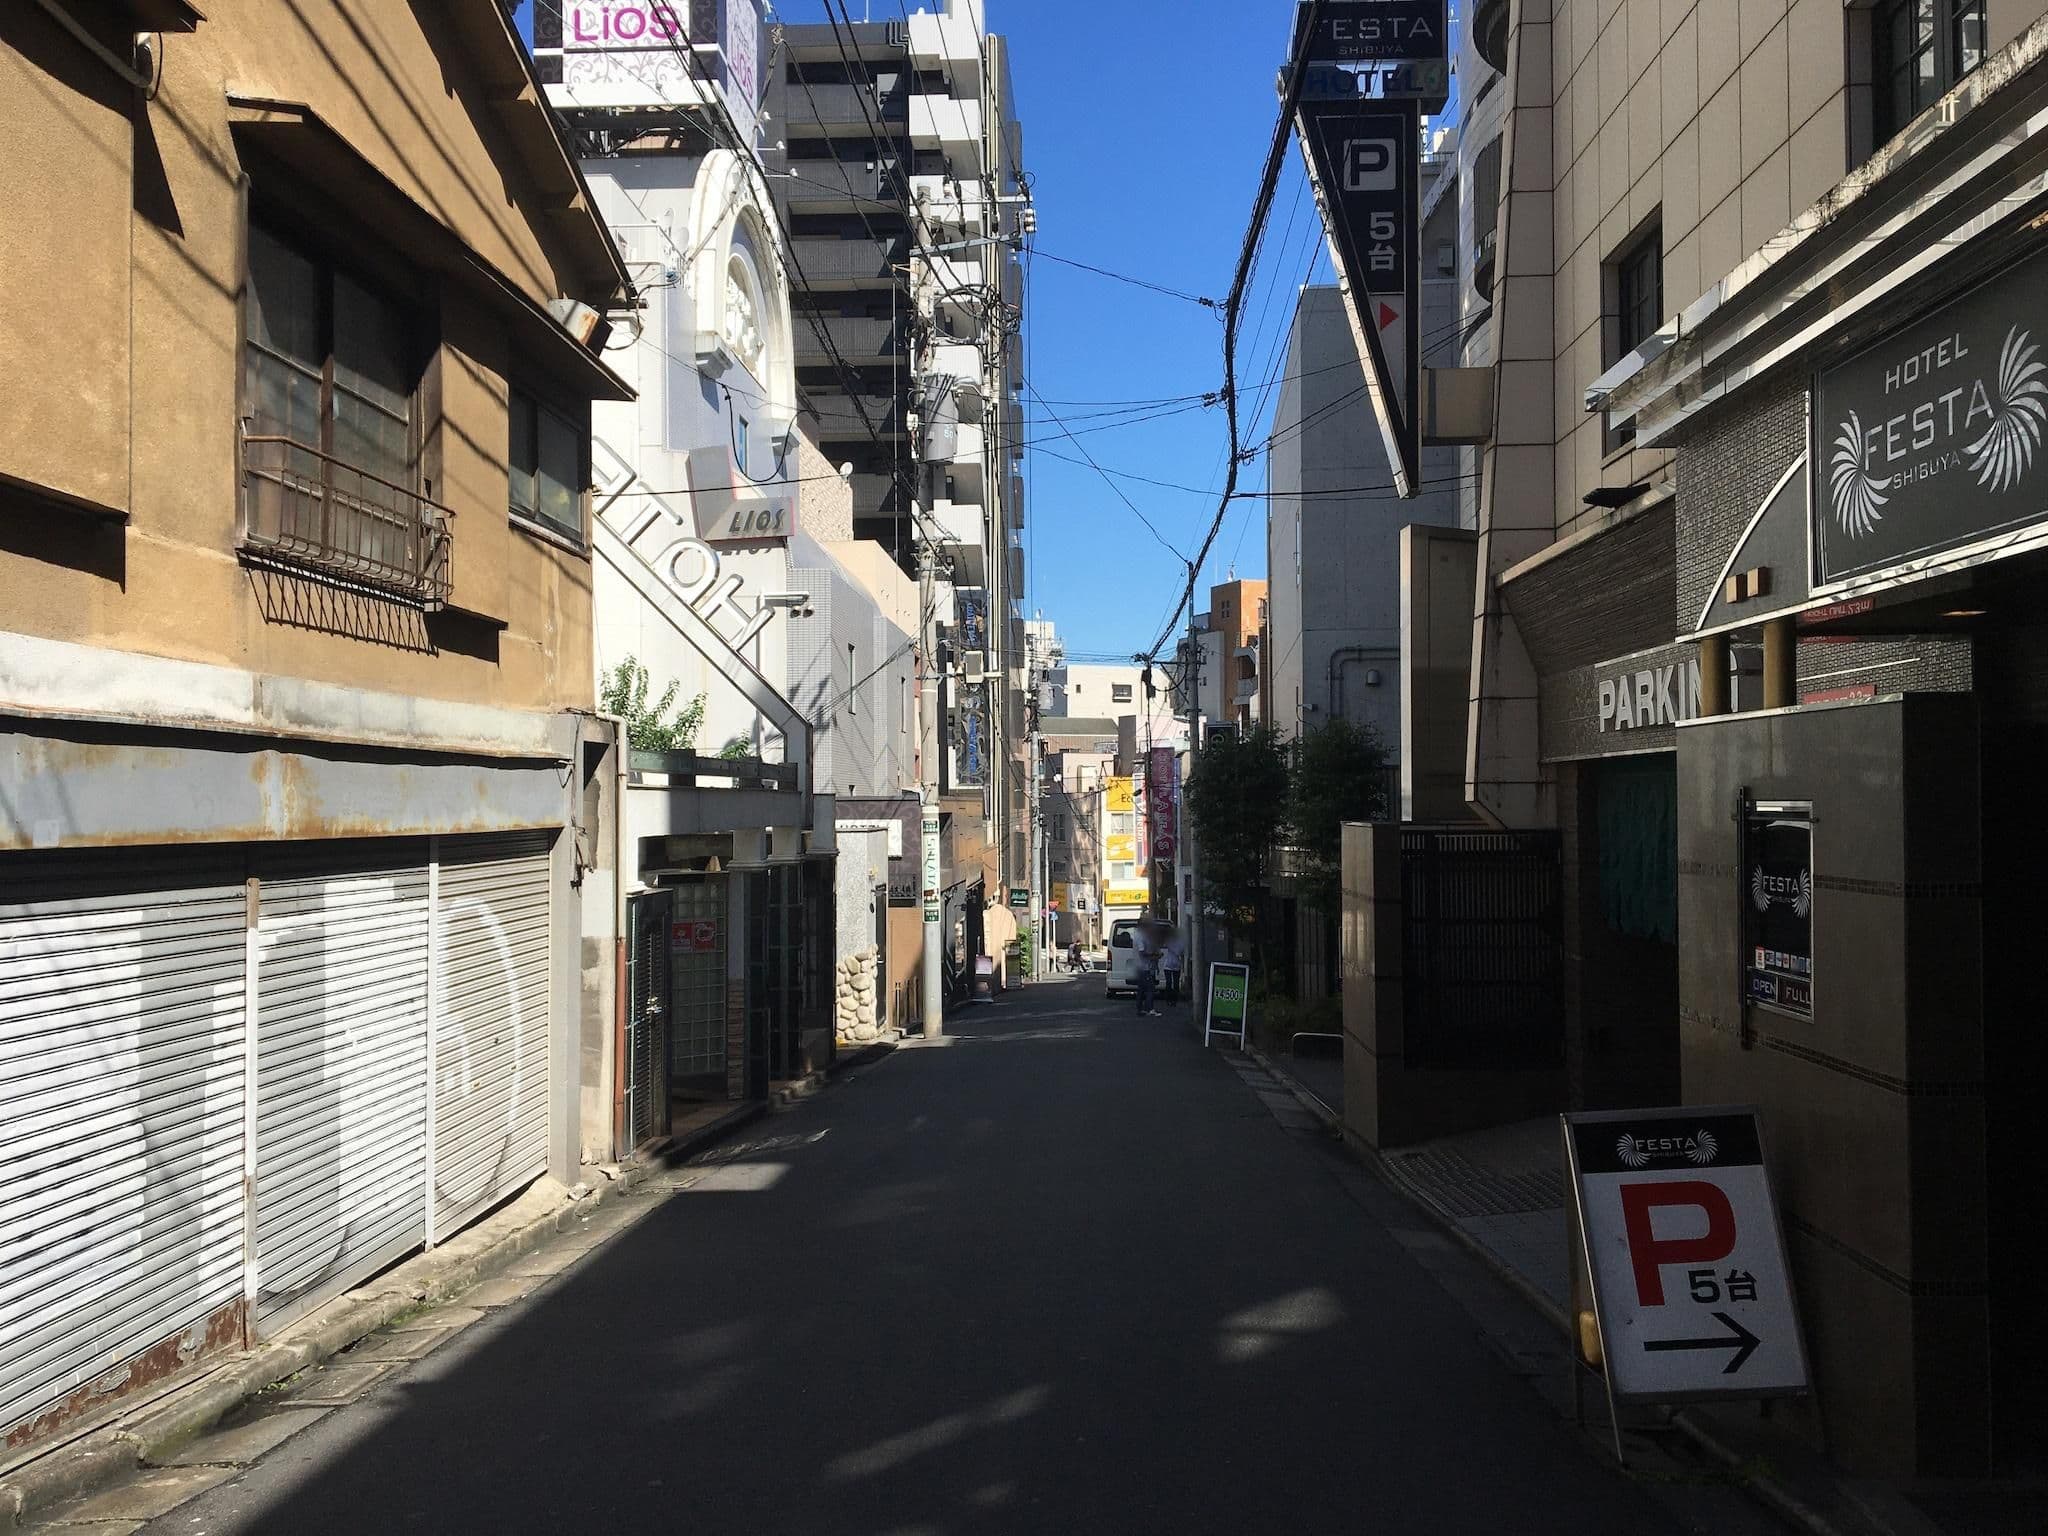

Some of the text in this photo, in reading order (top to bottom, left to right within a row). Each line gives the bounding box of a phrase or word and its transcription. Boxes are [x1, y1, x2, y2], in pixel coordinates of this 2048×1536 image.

[574, 6, 678, 41] LiOS
[1320, 17, 1433, 40] ESTA
[1350, 143, 1389, 186] P
[1368, 211, 1396, 271] 5台
[1885, 333, 1968, 395] HOTEL
[1865, 379, 1995, 471] FESTA
[1893, 451, 1961, 489] SHIBUYA
[1762, 875, 1799, 894] FESTA
[1753, 979, 1810, 1004] OPEN FULL
[1635, 1138, 1697, 1151] FESTA
[1619, 1180, 1737, 1307] P
[1688, 1269, 1758, 1304] 5台
